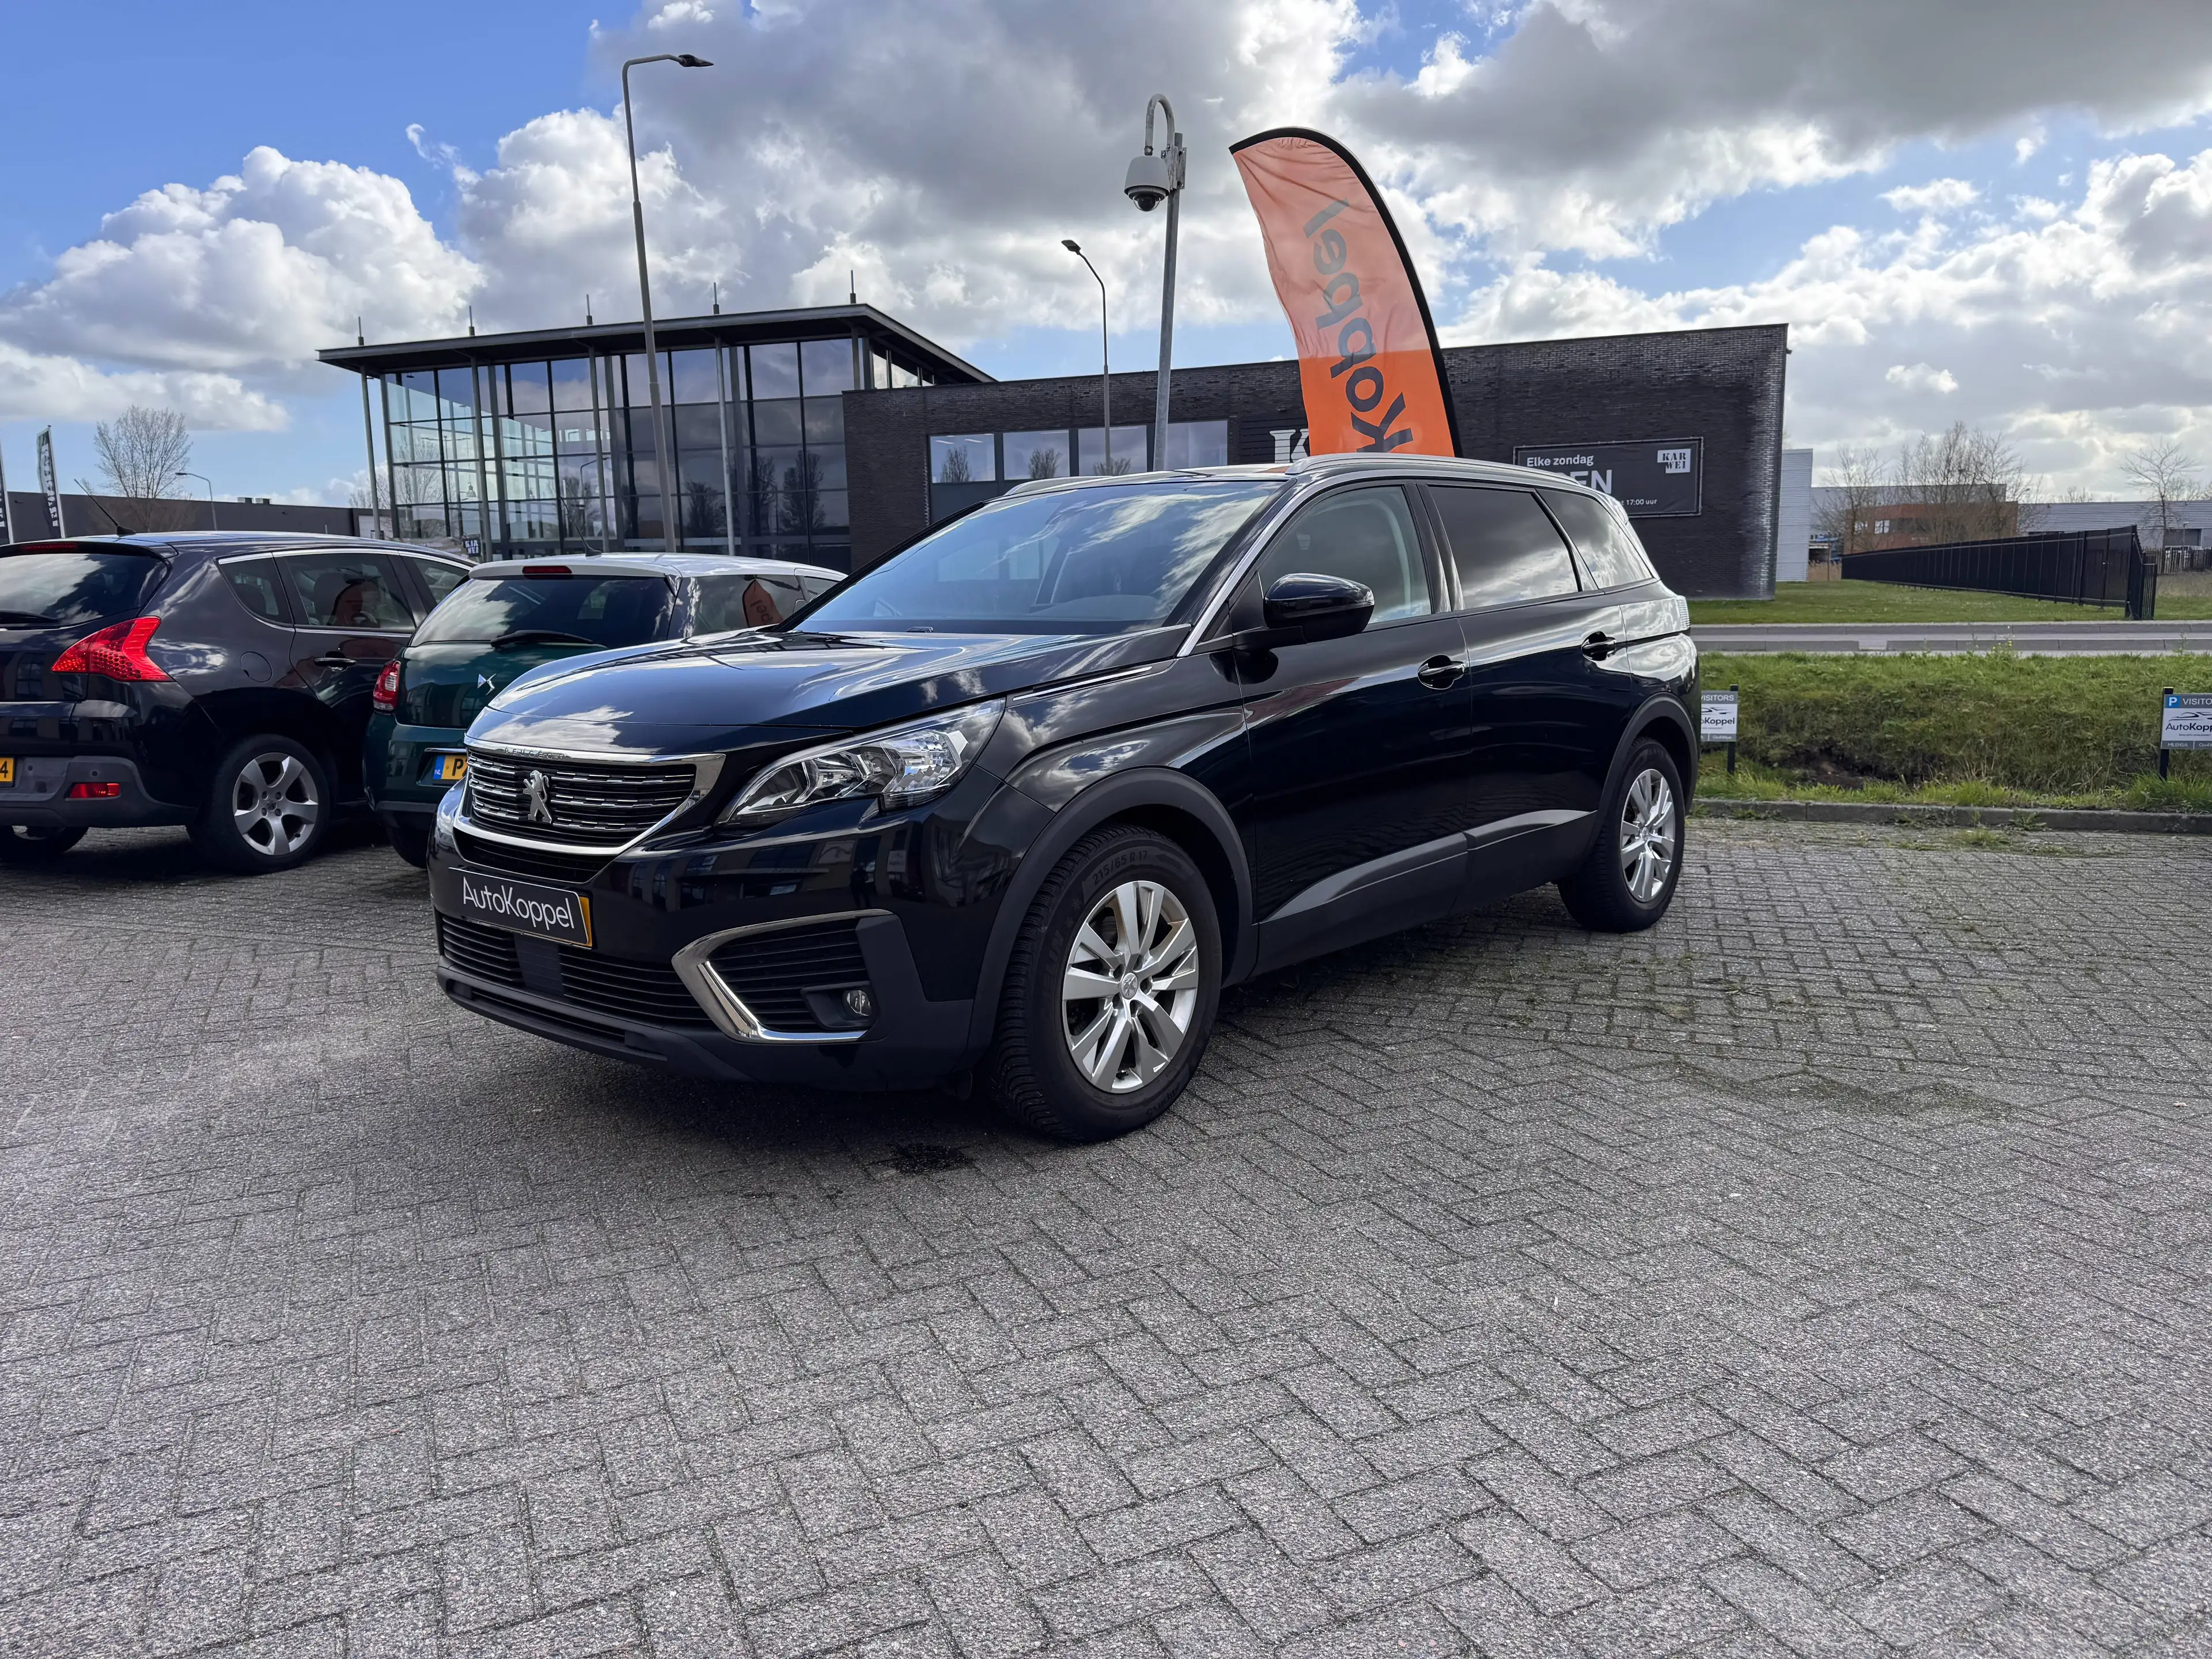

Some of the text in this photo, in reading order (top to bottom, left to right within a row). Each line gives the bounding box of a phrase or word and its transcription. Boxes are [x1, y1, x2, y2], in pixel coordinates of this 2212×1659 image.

[1527, 454, 1594, 467] Elke zondag
[1662, 453, 1686, 461] KAR
[0, 760, 8, 778] 4
[452, 758, 468, 776] P
[1092, 850, 1148, 885] 215/65 R 17
[463, 876, 574, 930] AutoKoppel
